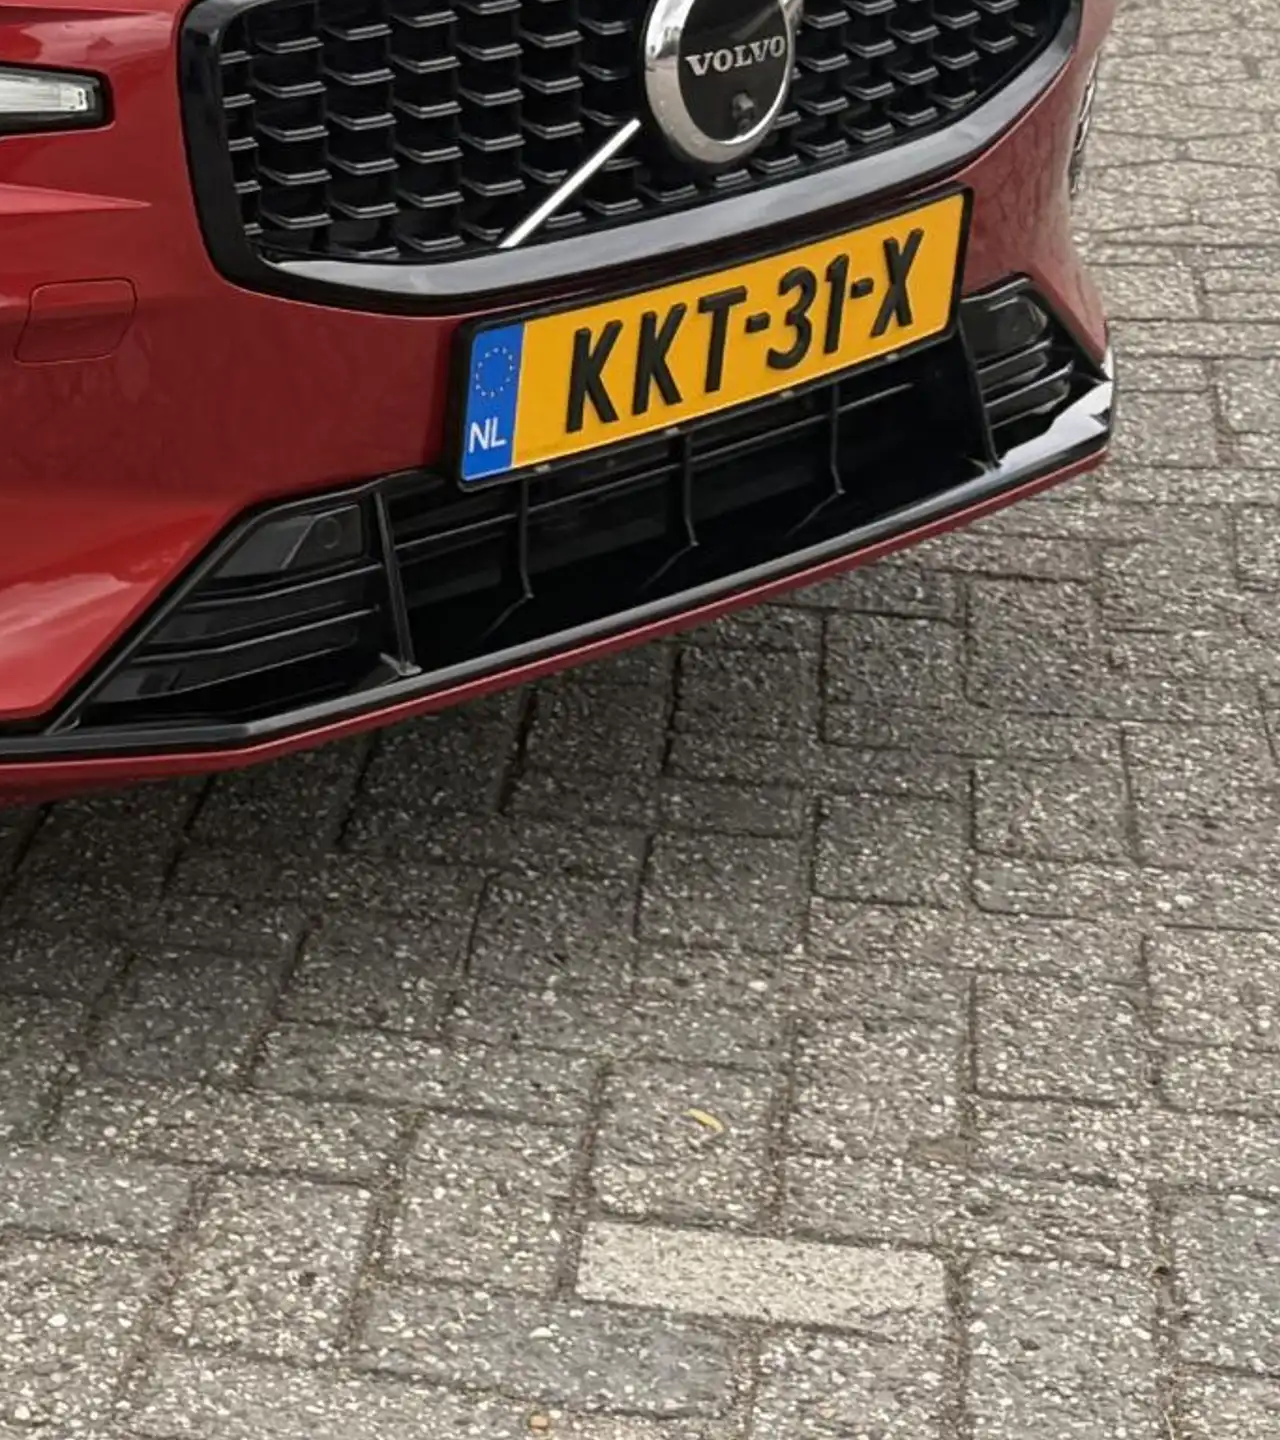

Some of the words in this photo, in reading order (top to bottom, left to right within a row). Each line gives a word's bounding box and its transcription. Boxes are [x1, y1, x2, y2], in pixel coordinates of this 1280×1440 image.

[686, 35, 785, 76] VOLVO
[564, 228, 925, 433] KKT-31-X
[468, 416, 507, 454] NL
